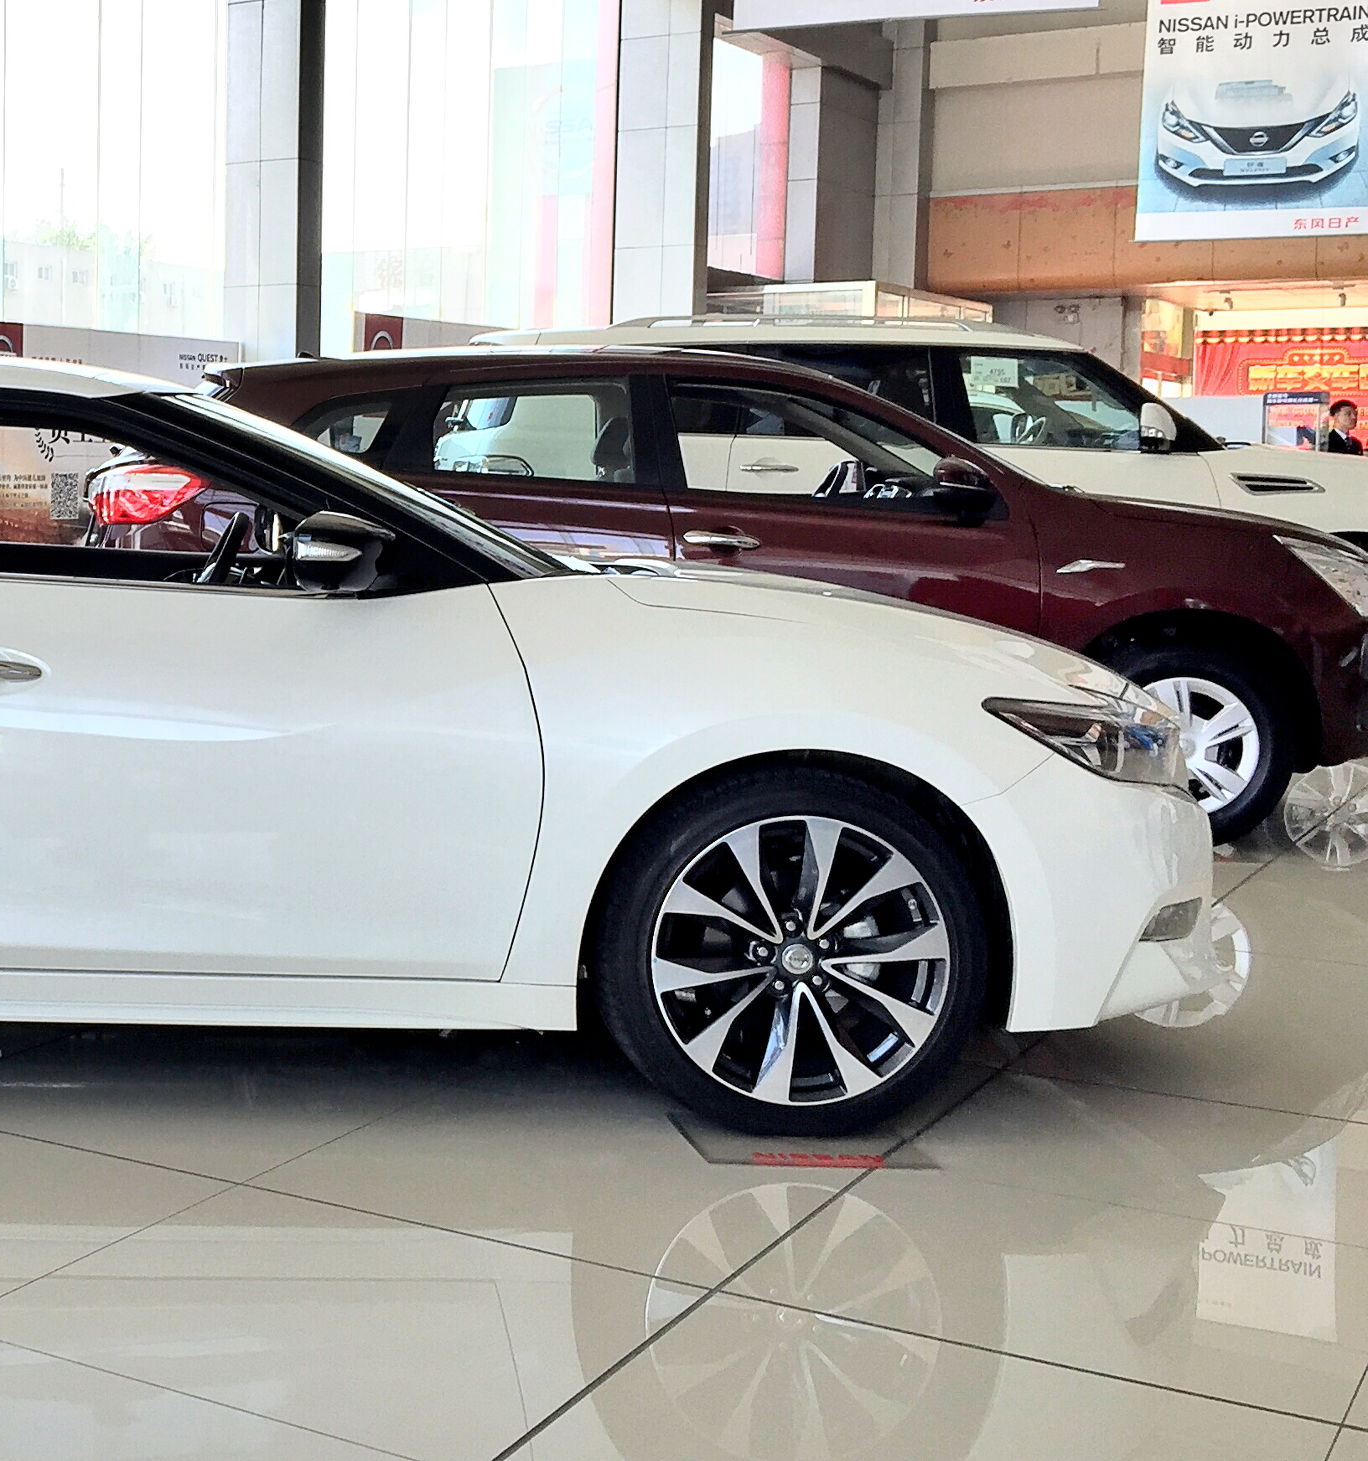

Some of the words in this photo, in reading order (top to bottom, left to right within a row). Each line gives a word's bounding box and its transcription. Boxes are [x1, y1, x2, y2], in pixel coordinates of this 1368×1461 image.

[1158, 15, 1229, 34] NISSAN
[1234, 5, 1368, 29] i-POWERTRAIN
[1157, 24, 1368, 55] 智能动力总成
[1293, 216, 1360, 230] 东风日产
[197, 352, 219, 363] QUEST
